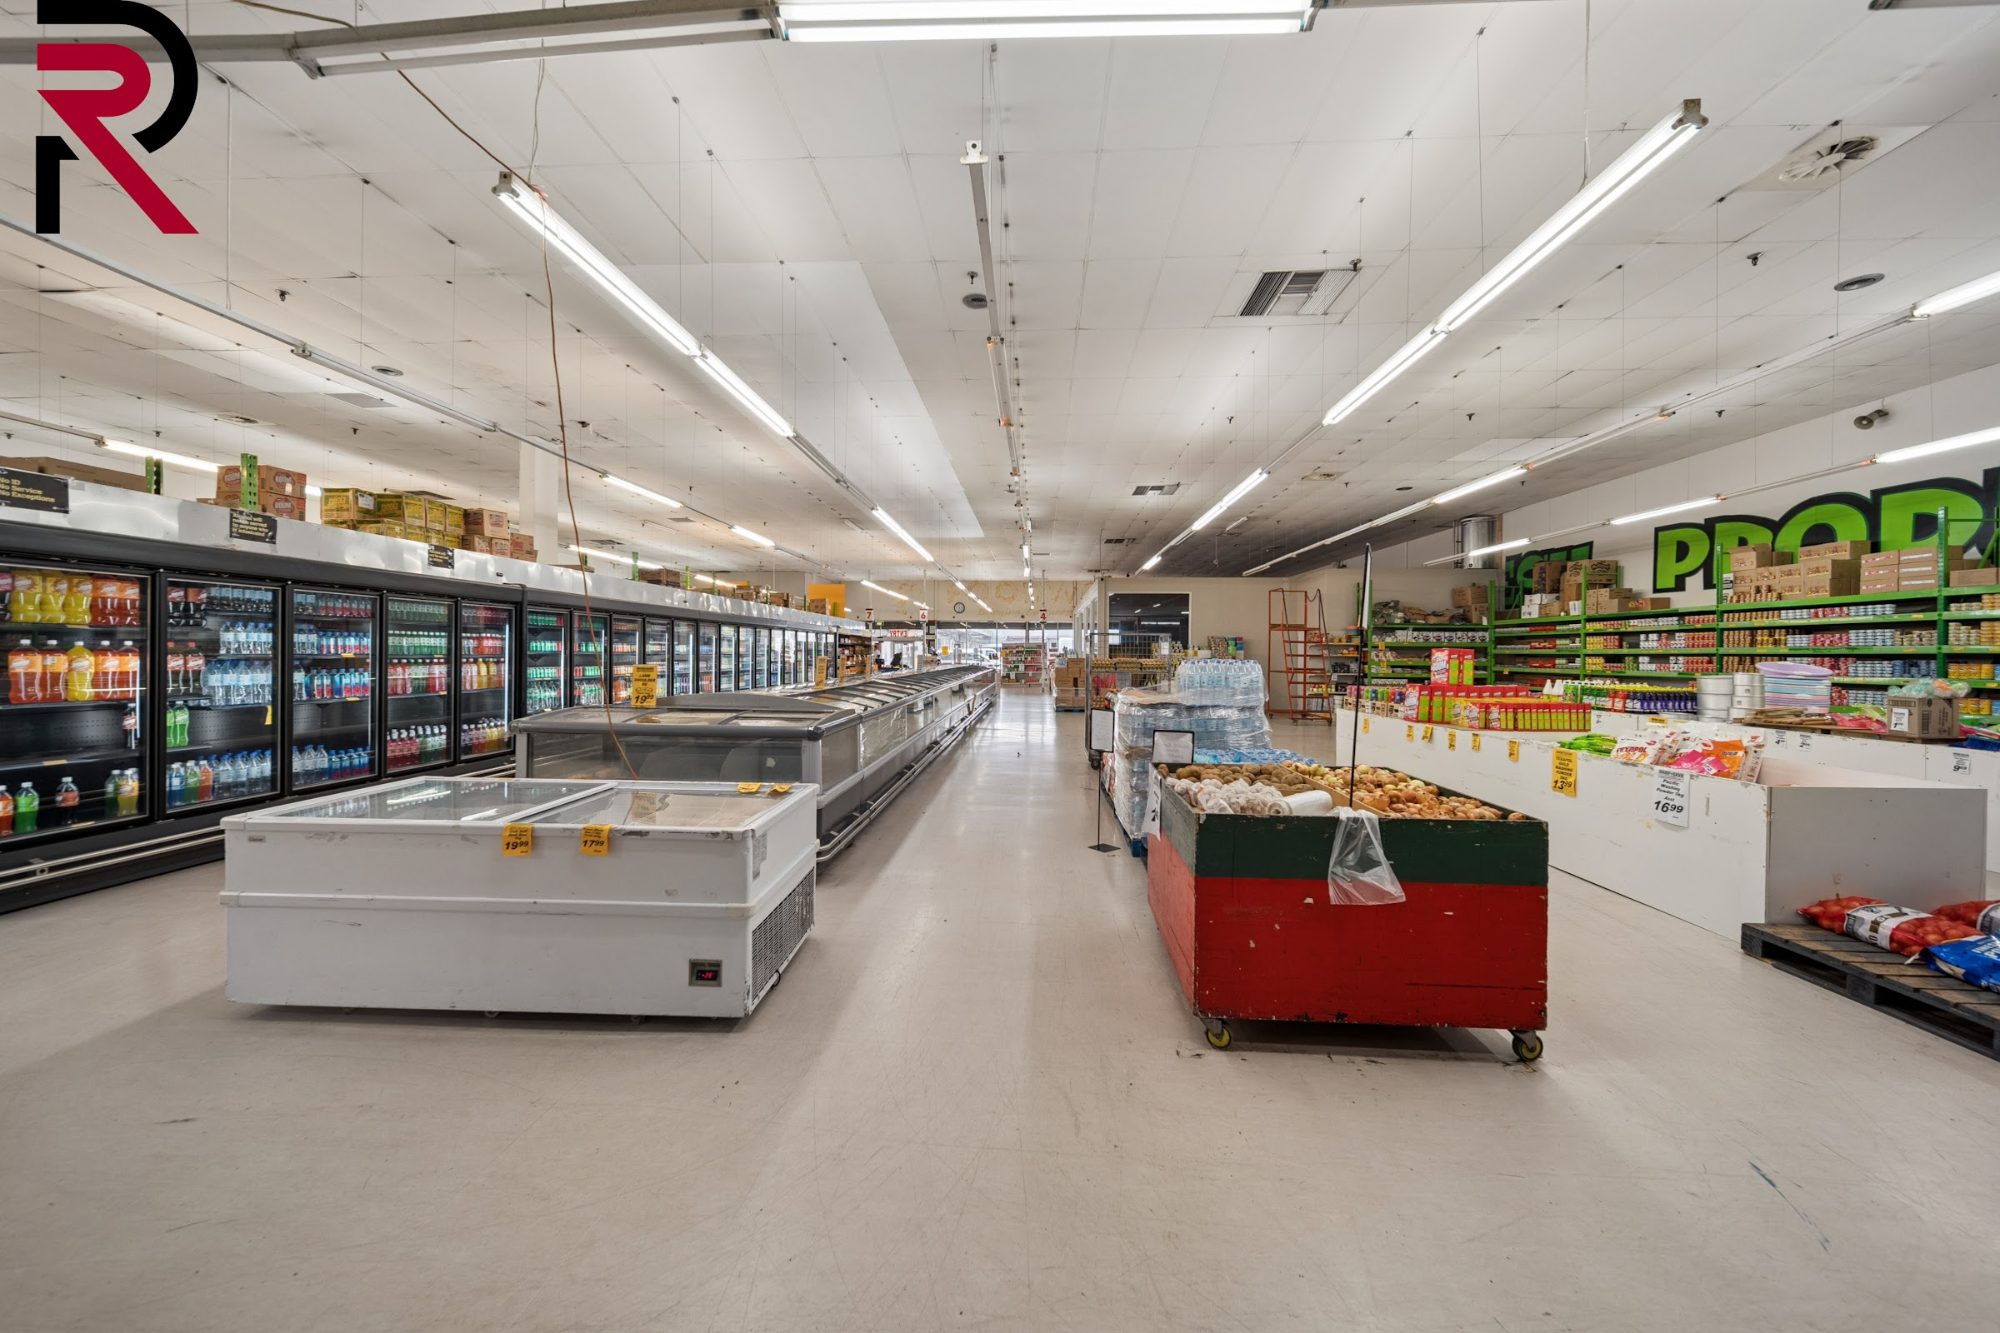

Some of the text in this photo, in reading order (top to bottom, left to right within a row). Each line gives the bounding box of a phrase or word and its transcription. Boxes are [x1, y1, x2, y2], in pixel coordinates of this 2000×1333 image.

[11, 485, 43, 495] Service
[11, 491, 56, 503] Exceptions
[1653, 467, 2000, 593] PROD
[1040, 612, 1047, 620] 4
[1656, 787, 1674, 795] Powder
[1660, 783, 1681, 792] Washing
